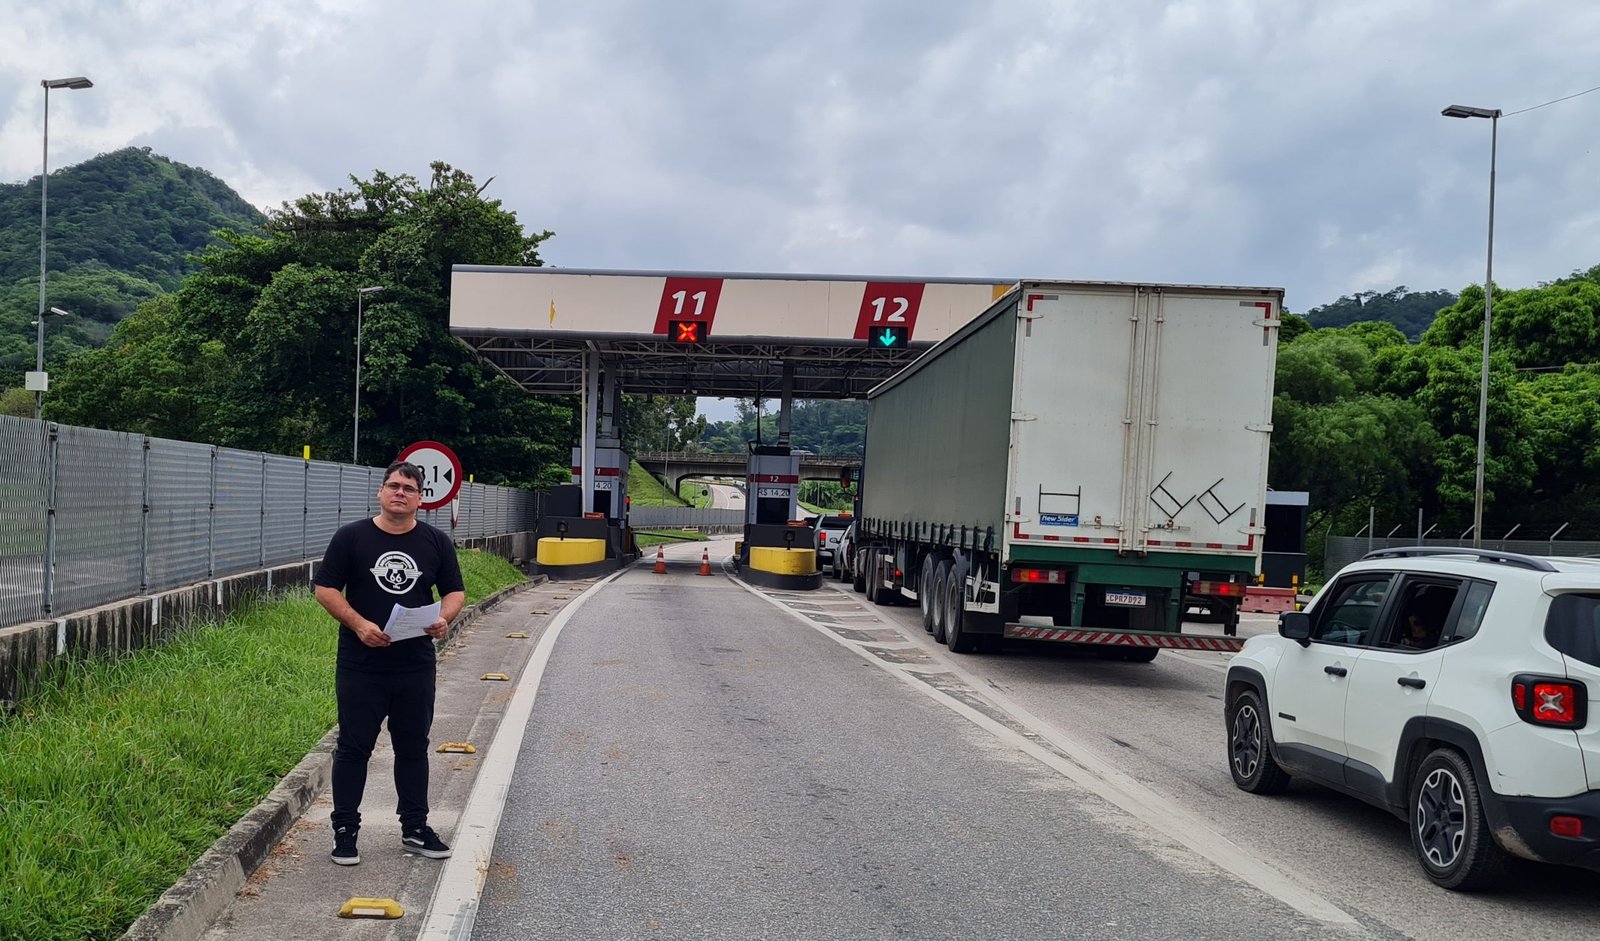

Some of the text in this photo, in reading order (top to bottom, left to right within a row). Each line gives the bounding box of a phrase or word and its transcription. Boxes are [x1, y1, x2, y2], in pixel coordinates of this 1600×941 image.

[671, 290, 707, 315] 11
[870, 297, 909, 322] 12
[389, 573, 402, 582] 66
